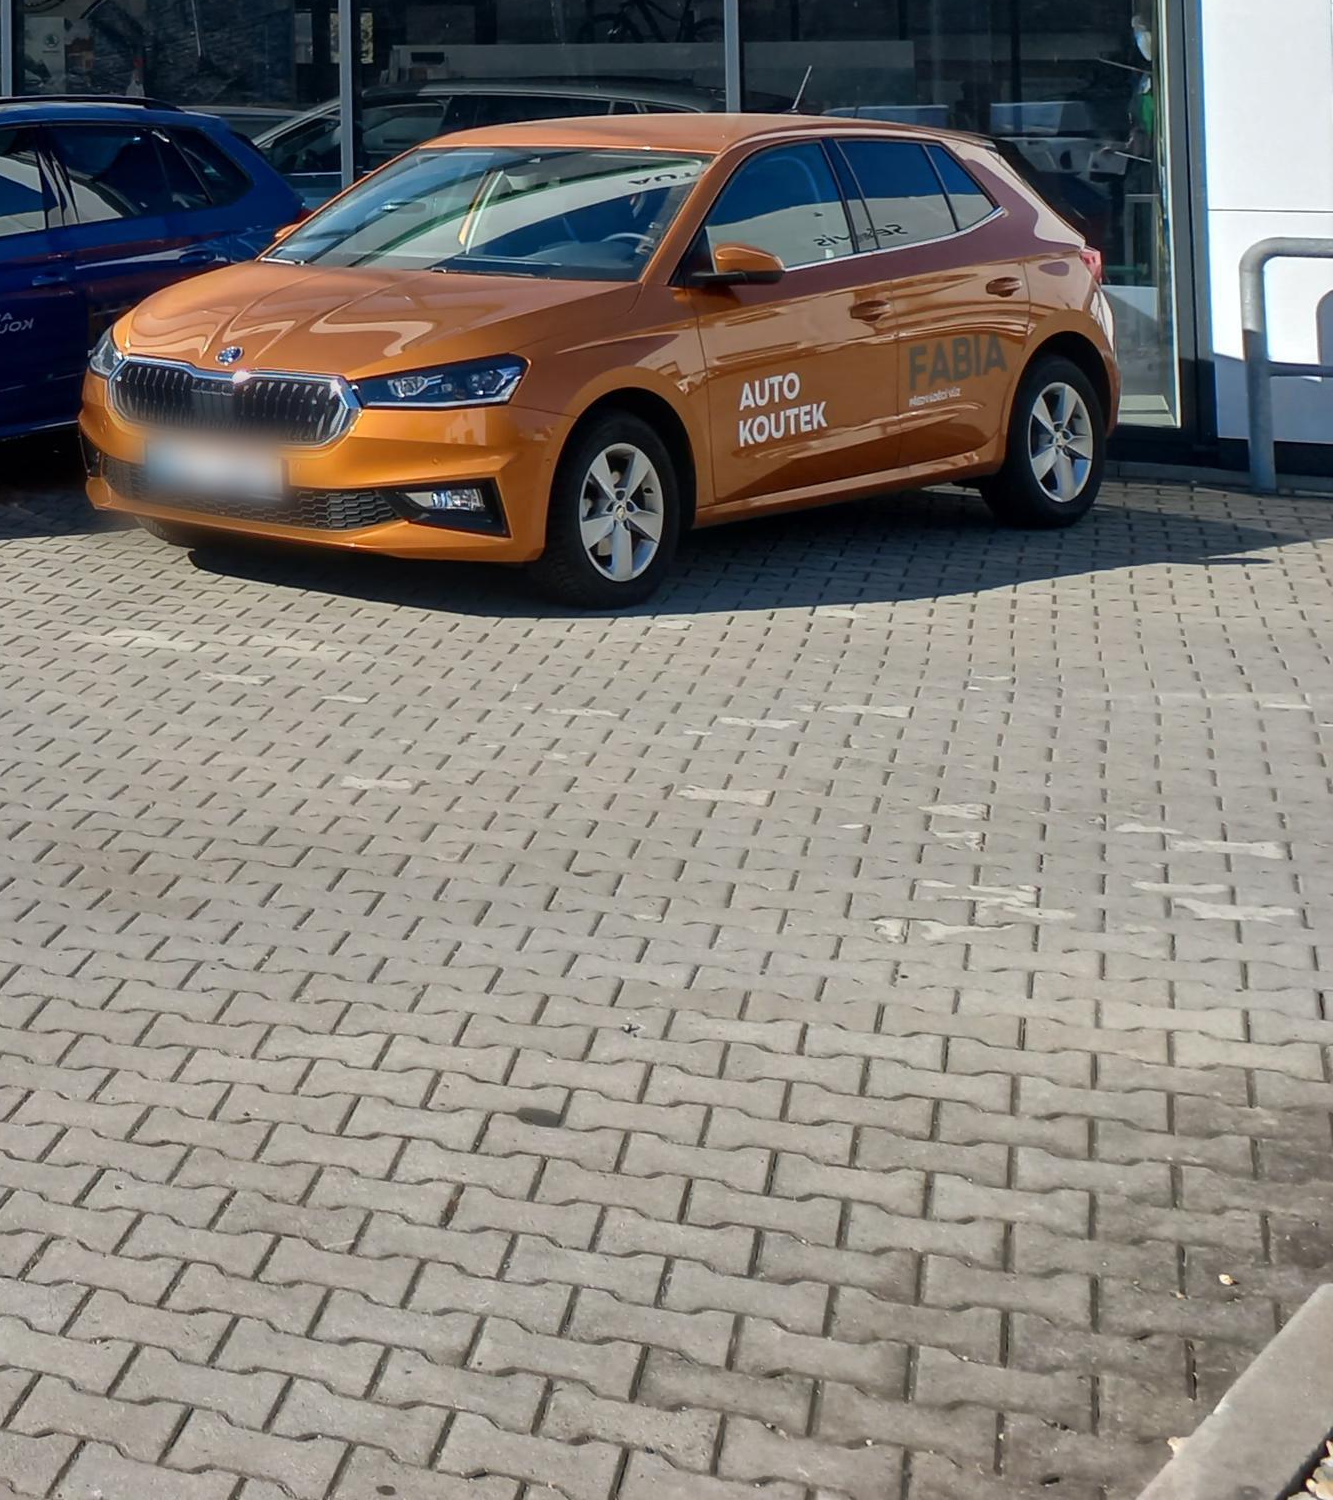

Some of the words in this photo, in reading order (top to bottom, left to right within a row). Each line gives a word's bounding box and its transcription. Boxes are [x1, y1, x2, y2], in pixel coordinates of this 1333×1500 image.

[909, 332, 1008, 390] FABIA
[739, 372, 801, 412] AUTO
[739, 401, 828, 448] KOUTEK
